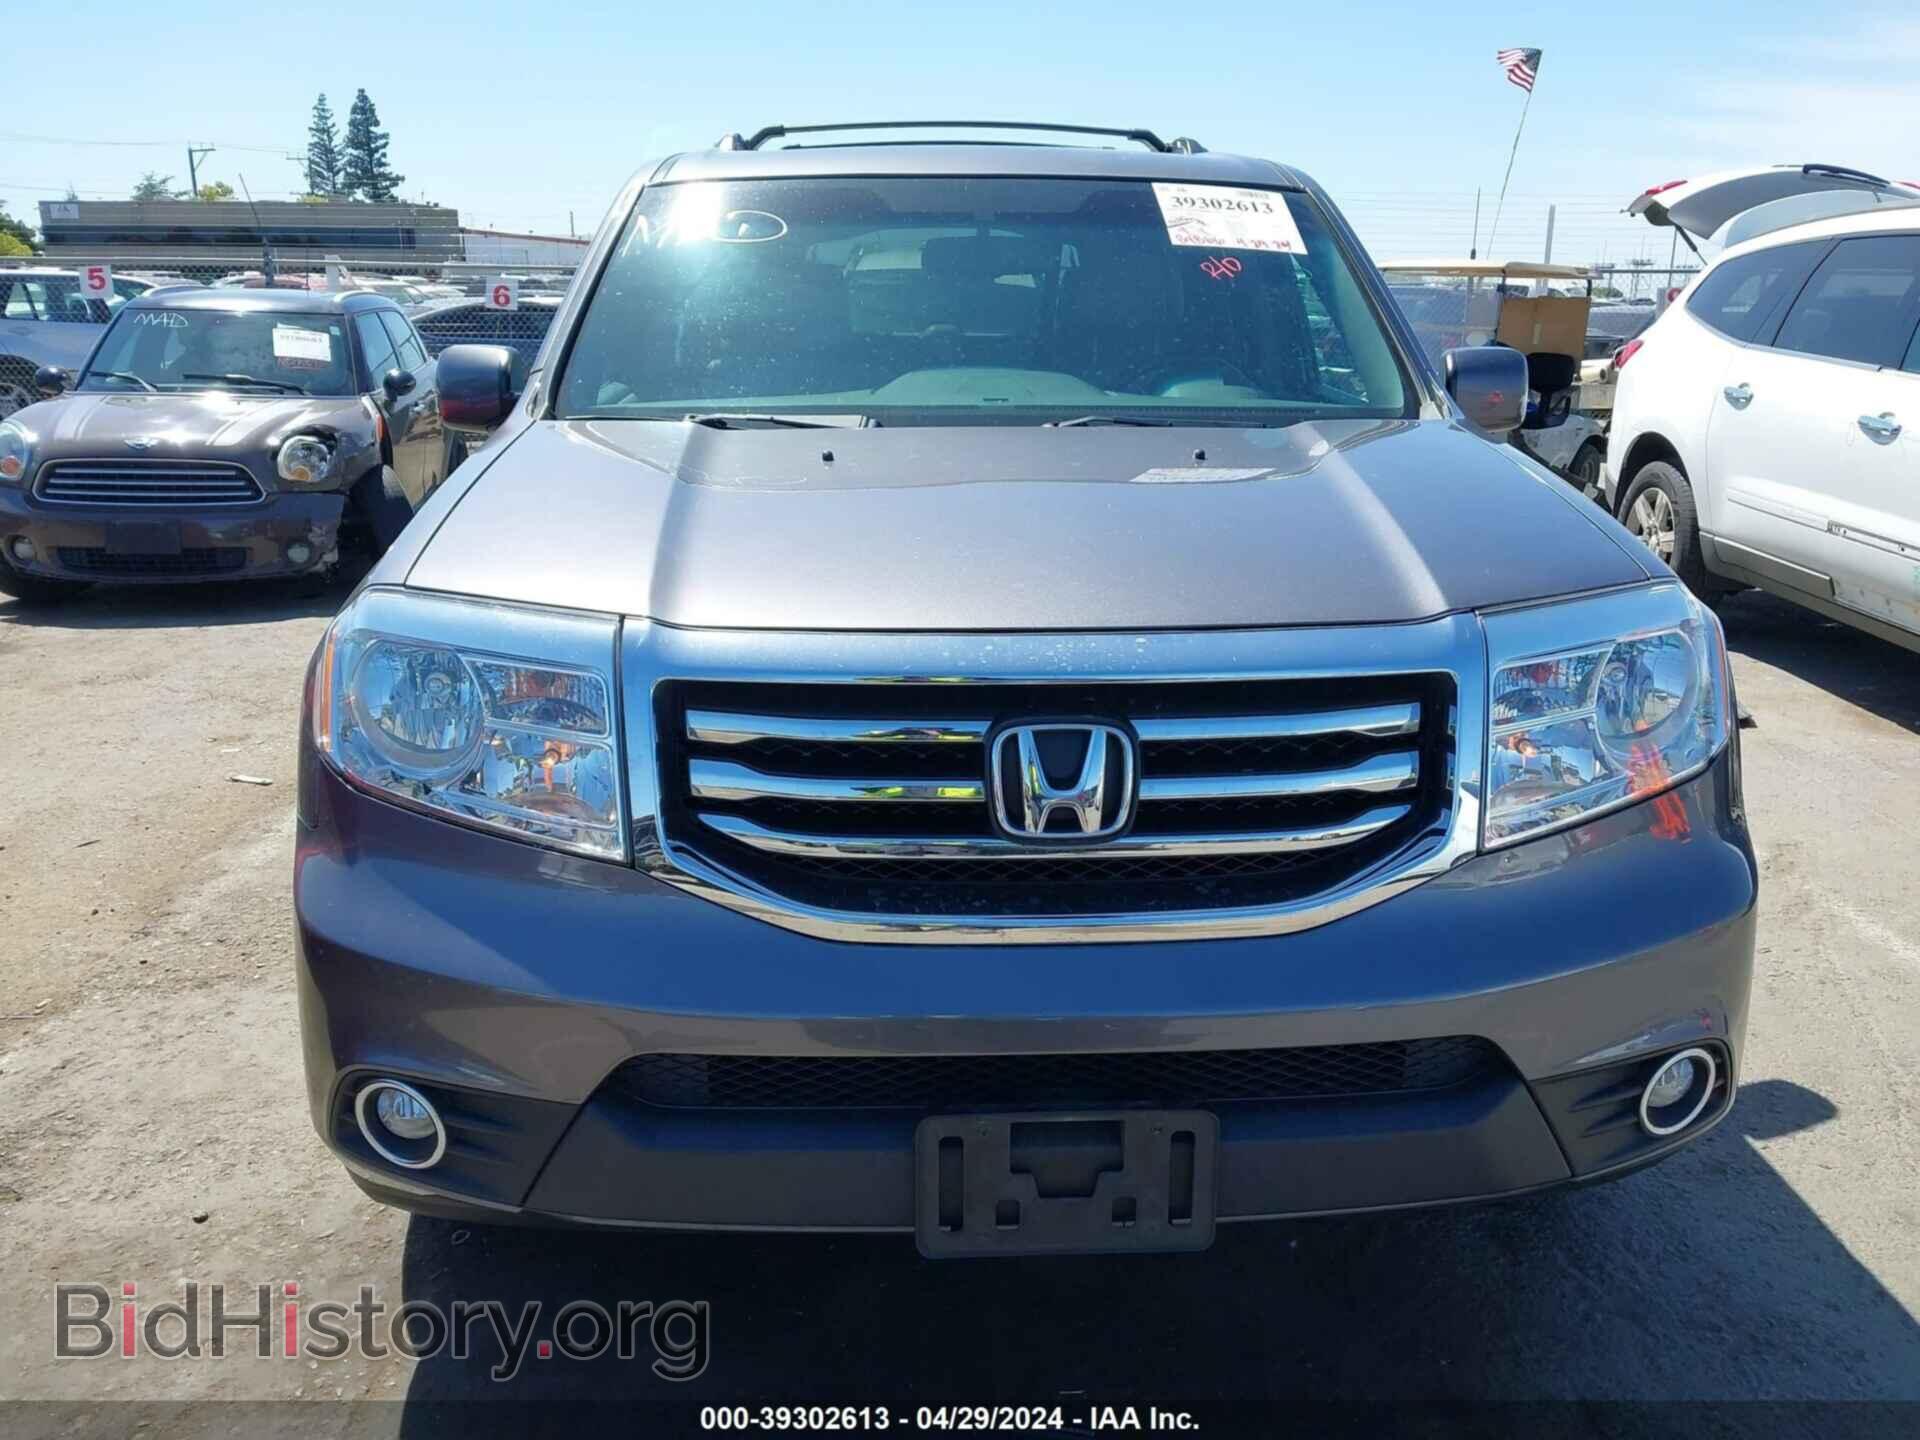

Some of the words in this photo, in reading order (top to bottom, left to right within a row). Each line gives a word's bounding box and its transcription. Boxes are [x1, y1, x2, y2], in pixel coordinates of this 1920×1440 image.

[1171, 195, 1274, 214] 39302613
[88, 267, 106, 290] 5
[493, 284, 511, 307] 6
[133, 311, 189, 328] MAD
